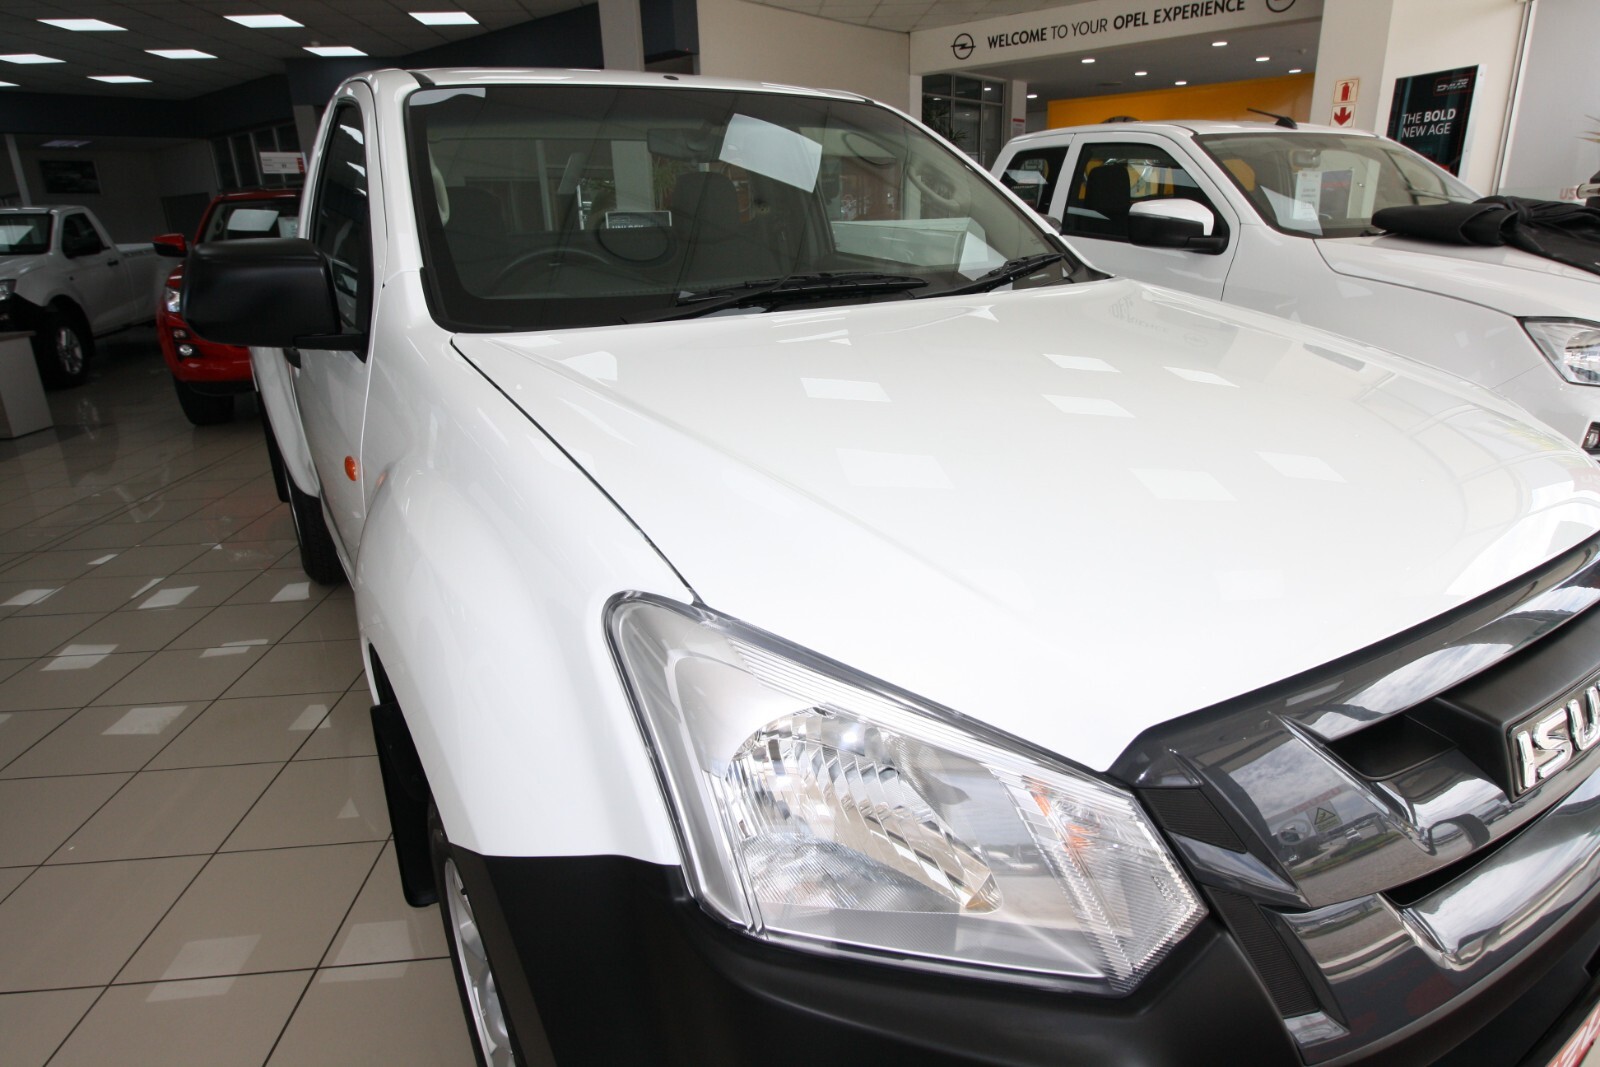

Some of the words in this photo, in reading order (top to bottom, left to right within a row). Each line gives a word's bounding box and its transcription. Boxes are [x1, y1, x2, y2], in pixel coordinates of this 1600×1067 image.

[987, 27, 1048, 49] WELCOME
[1051, 24, 1068, 40] TO
[1071, 18, 1108, 37] YOUR
[1113, 11, 1149, 30] OPEL
[1153, 0, 1246, 25] EXPERIENCE
[1401, 125, 1428, 138] NEW
[1427, 122, 1452, 136] AGE
[1402, 111, 1423, 125] THE
[1423, 108, 1457, 123] BOLD
[1516, 679, 1600, 788] ISU
